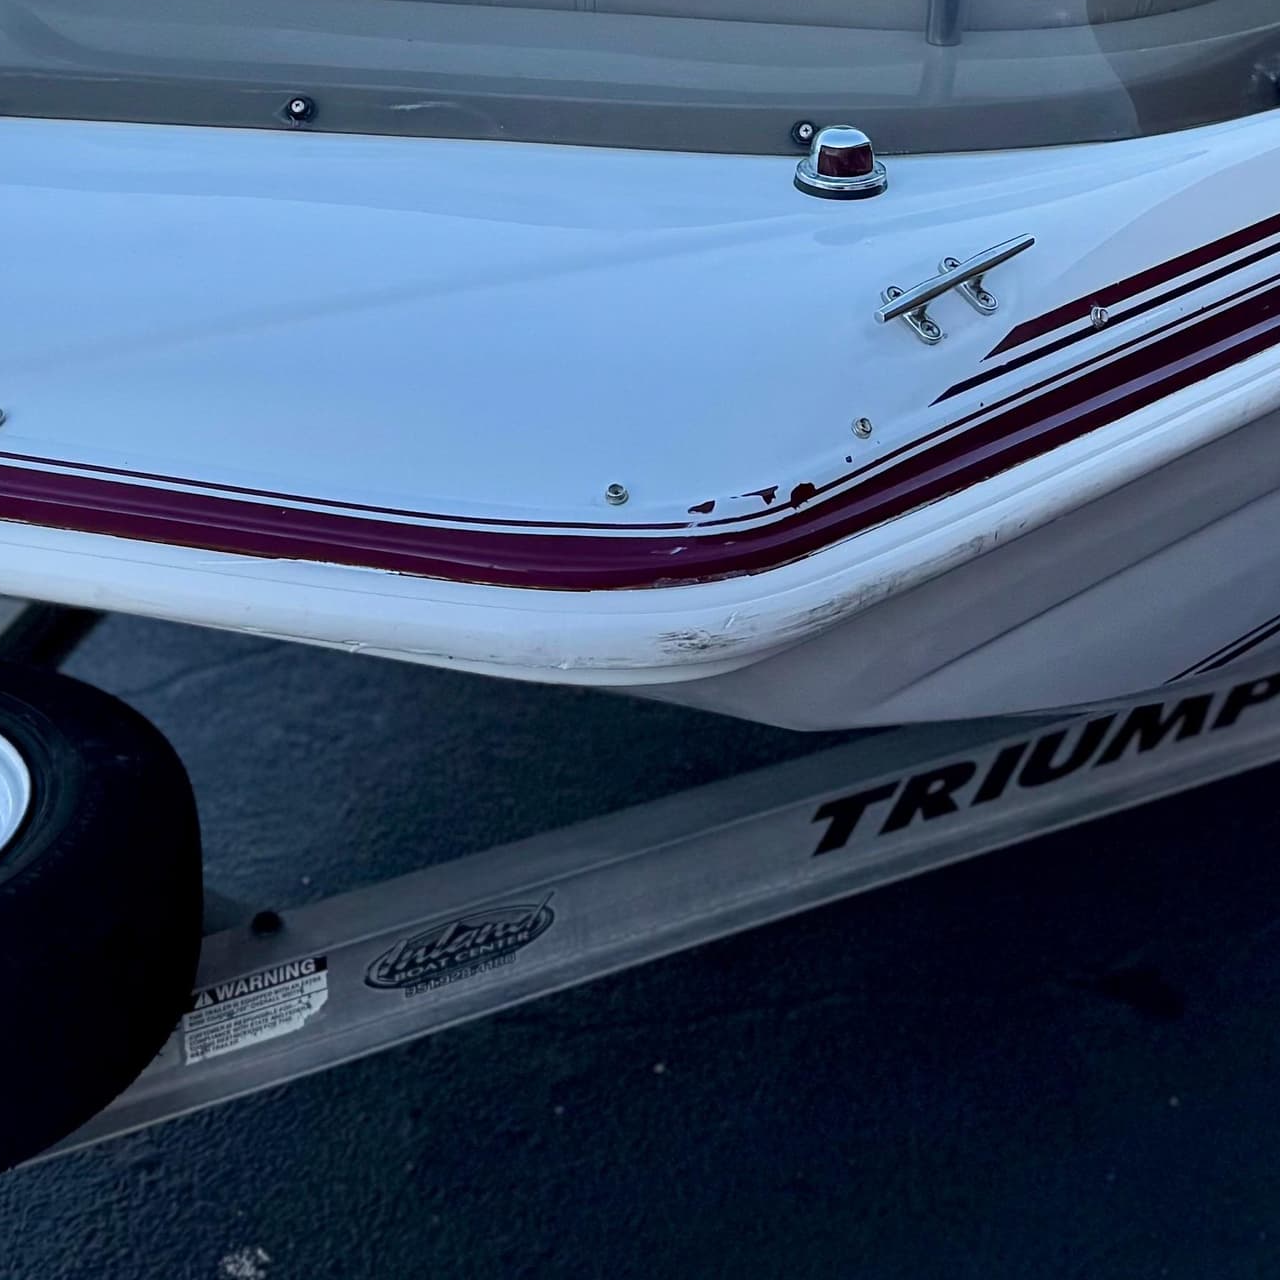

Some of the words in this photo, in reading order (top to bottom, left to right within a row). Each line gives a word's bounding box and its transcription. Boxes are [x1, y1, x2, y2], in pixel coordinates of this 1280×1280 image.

[454, 931, 530, 962] CENTER
[215, 958, 316, 1001] WARNING
[394, 958, 450, 982] BOAT
